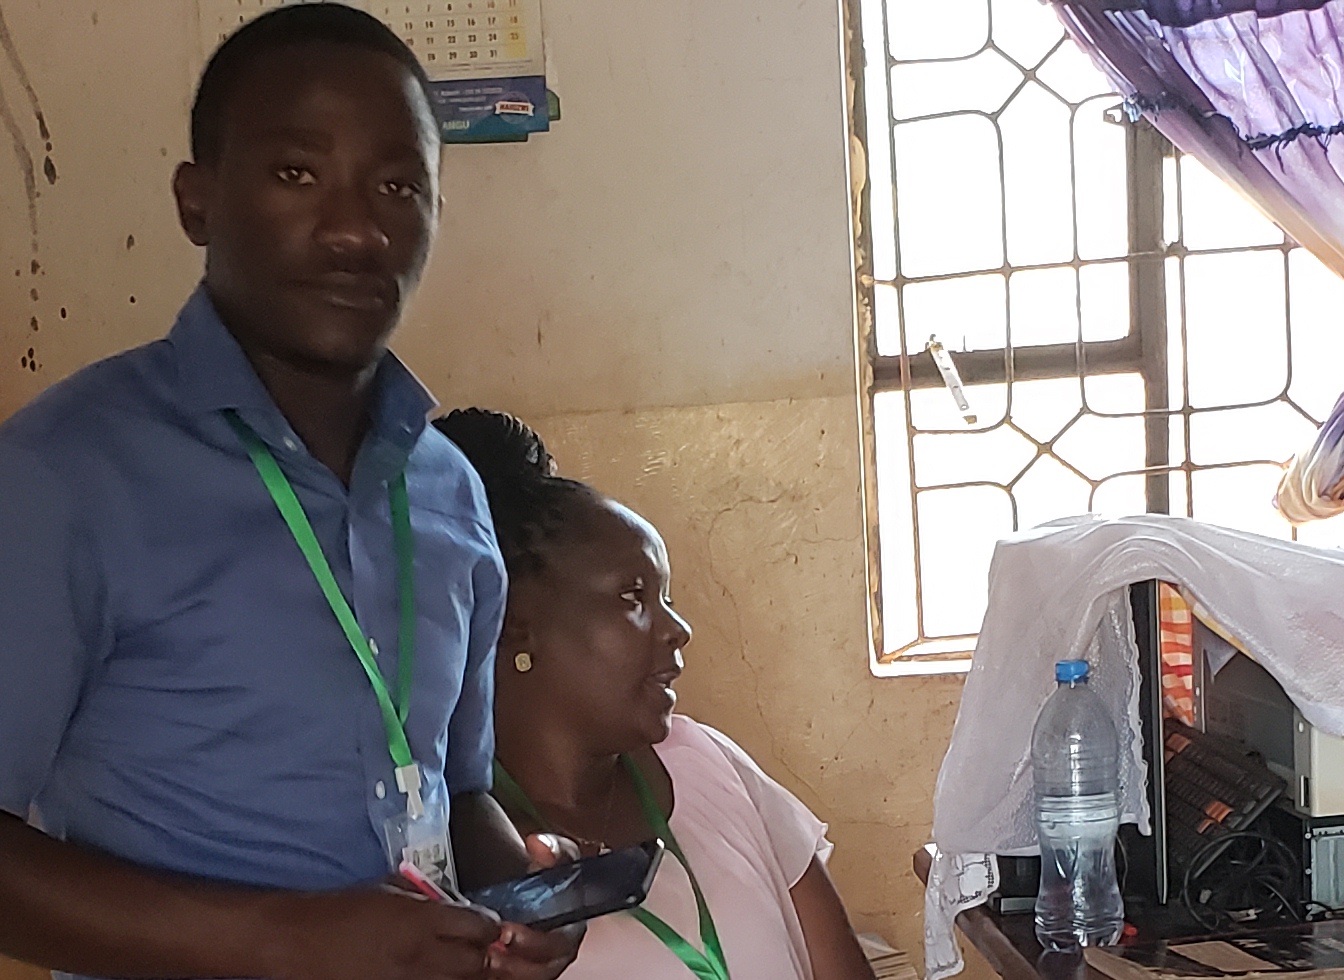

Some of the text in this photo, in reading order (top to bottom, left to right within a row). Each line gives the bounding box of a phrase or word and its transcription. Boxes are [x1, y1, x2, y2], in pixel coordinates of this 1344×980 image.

[447, 19, 455, 27] 15
[468, 18, 476, 26] 16
[488, 17, 496, 25] 17
